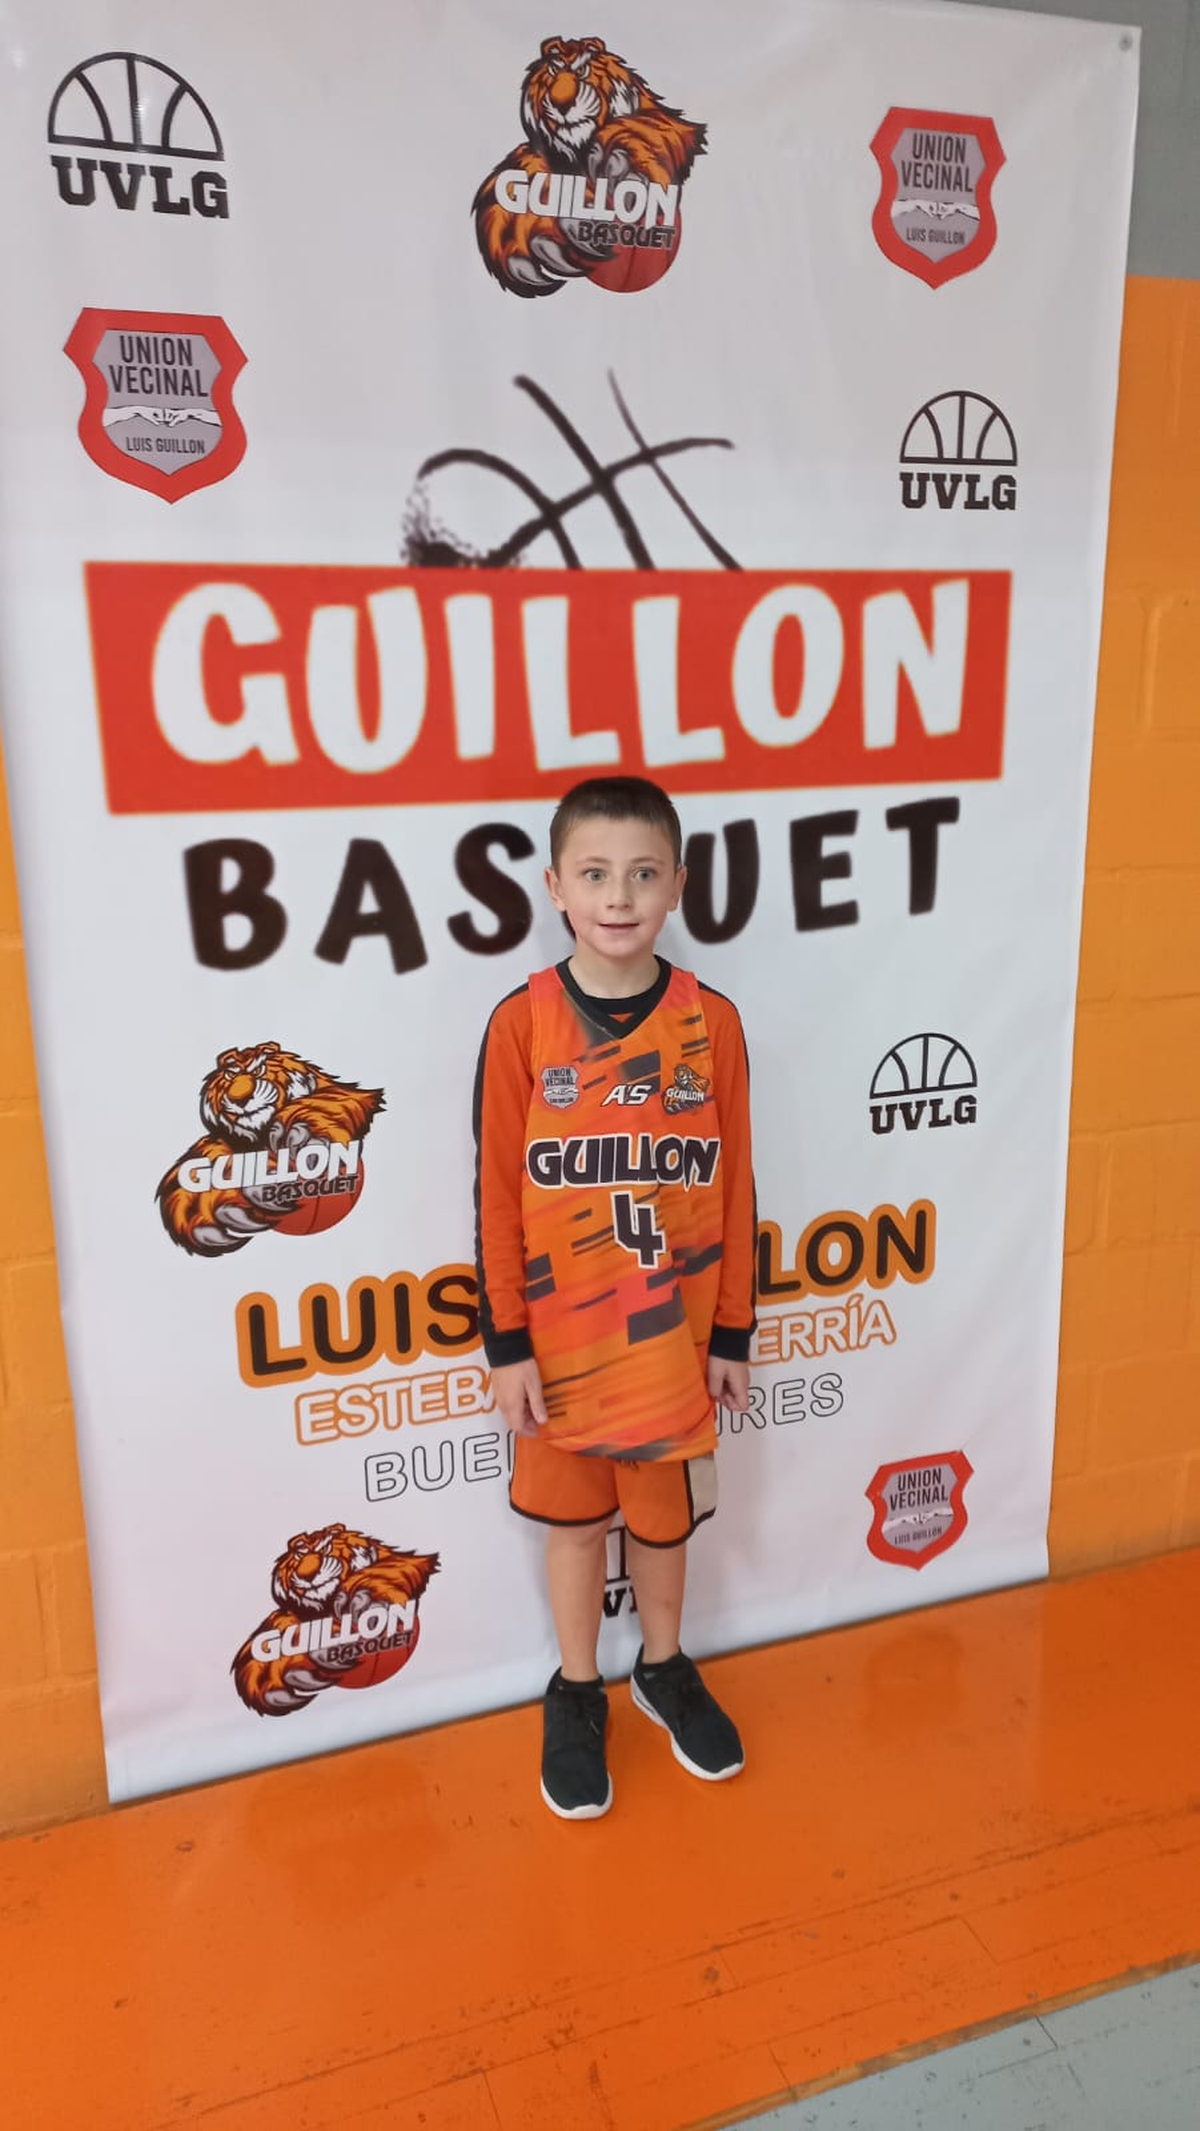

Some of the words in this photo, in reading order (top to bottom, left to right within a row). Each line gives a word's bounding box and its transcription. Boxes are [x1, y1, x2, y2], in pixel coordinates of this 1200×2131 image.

[912, 132, 967, 164] UNION
[50, 155, 230, 219] UVLG
[901, 160, 973, 193] VECINAL
[495, 169, 678, 230] GUILLON
[577, 220, 676, 250] BASQUET
[906, 227, 926, 242] LUIS
[928, 229, 965, 245] GUILLON
[119, 335, 193, 367] UNION
[108, 364, 209, 397] VECINAL
[125, 436, 152, 452] LUIS
[156, 438, 205, 454] GUILLON
[899, 471, 1018, 510] UVLG
[151, 579, 970, 774] GUILLON
[183, 796, 961, 975] BASUET
[869, 1094, 978, 1135] UVLG
[177, 1139, 360, 1193] GUILLON
[526, 1133, 721, 1192] GUILLON
[262, 1174, 358, 1203] BASQUET
[610, 1190, 666, 1269] 4
[244, 1272, 481, 1379] LUIS
[897, 1467, 942, 1491] UNION
[889, 1484, 948, 1511] VECINAL
[251, 1600, 416, 1662] GUILLON
[326, 1631, 413, 1663] BASQUET
